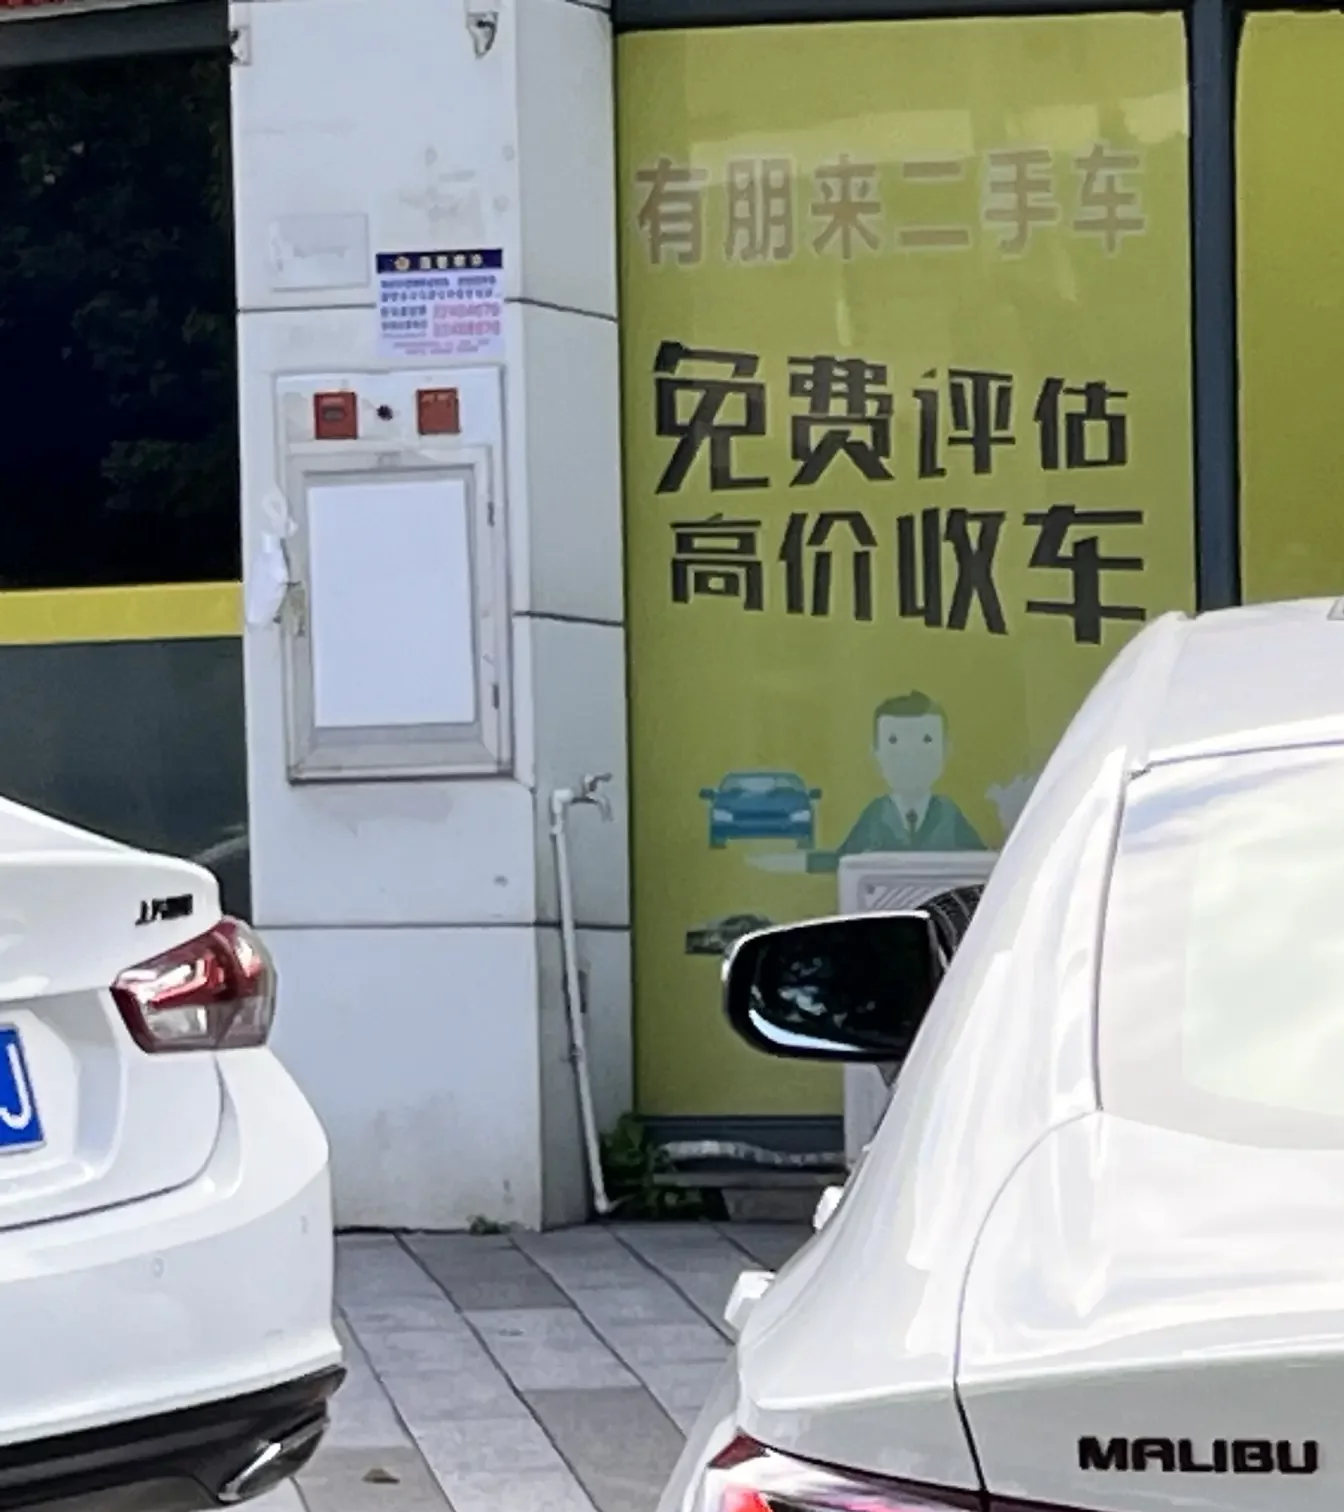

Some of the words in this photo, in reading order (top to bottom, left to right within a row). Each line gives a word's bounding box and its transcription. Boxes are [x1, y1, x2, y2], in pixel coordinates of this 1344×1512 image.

[634, 142, 1147, 267] 有朋来二手车
[654, 340, 1129, 494] 免费评估
[670, 503, 1148, 645] 高价收车
[1078, 1436, 1319, 1475] MALIBU
